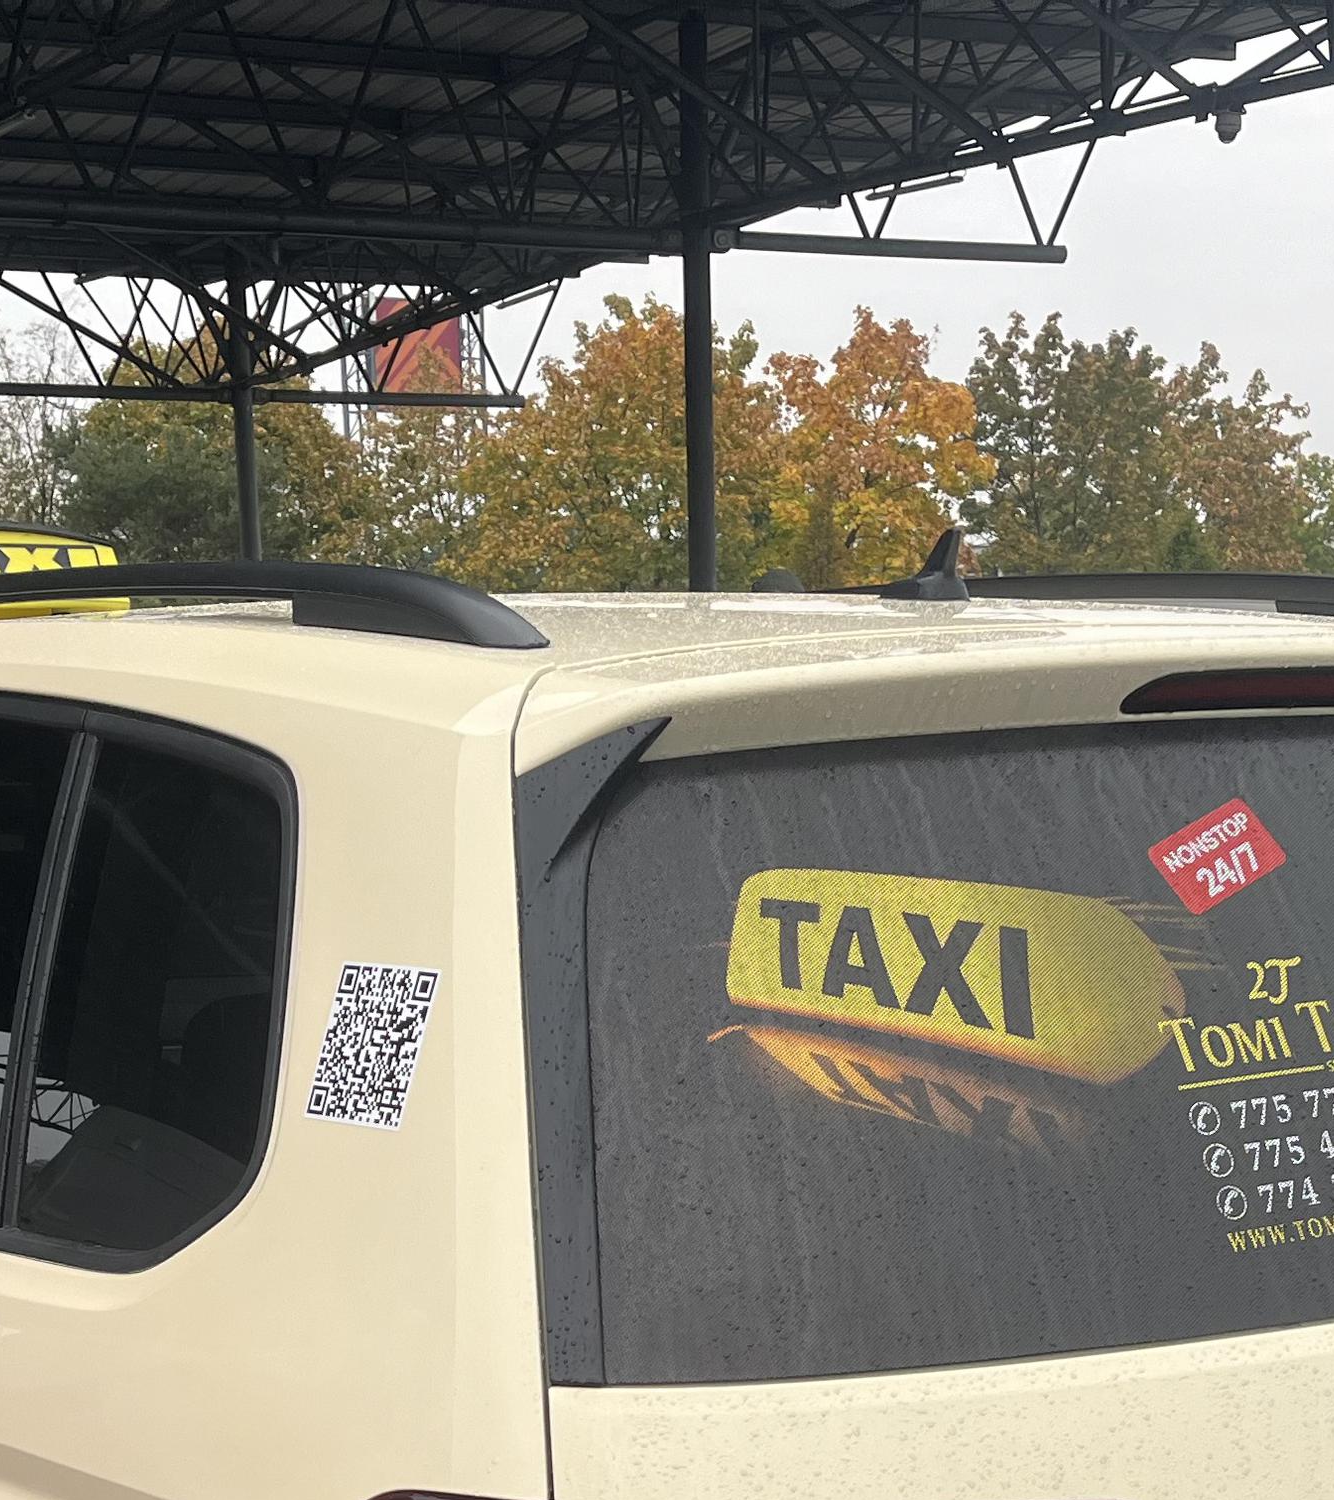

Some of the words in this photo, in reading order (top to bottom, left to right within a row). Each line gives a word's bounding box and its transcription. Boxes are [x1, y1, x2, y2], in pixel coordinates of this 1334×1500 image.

[1161, 811, 1248, 872] NONSTOP
[1196, 841, 1259, 898] 24/7
[760, 898, 1035, 1040] TAXI
[1157, 1016, 1292, 1073] TOMI
[1231, 1094, 1292, 1130] 775
[1244, 1135, 1305, 1172] 775
[1257, 1176, 1321, 1214] 774
